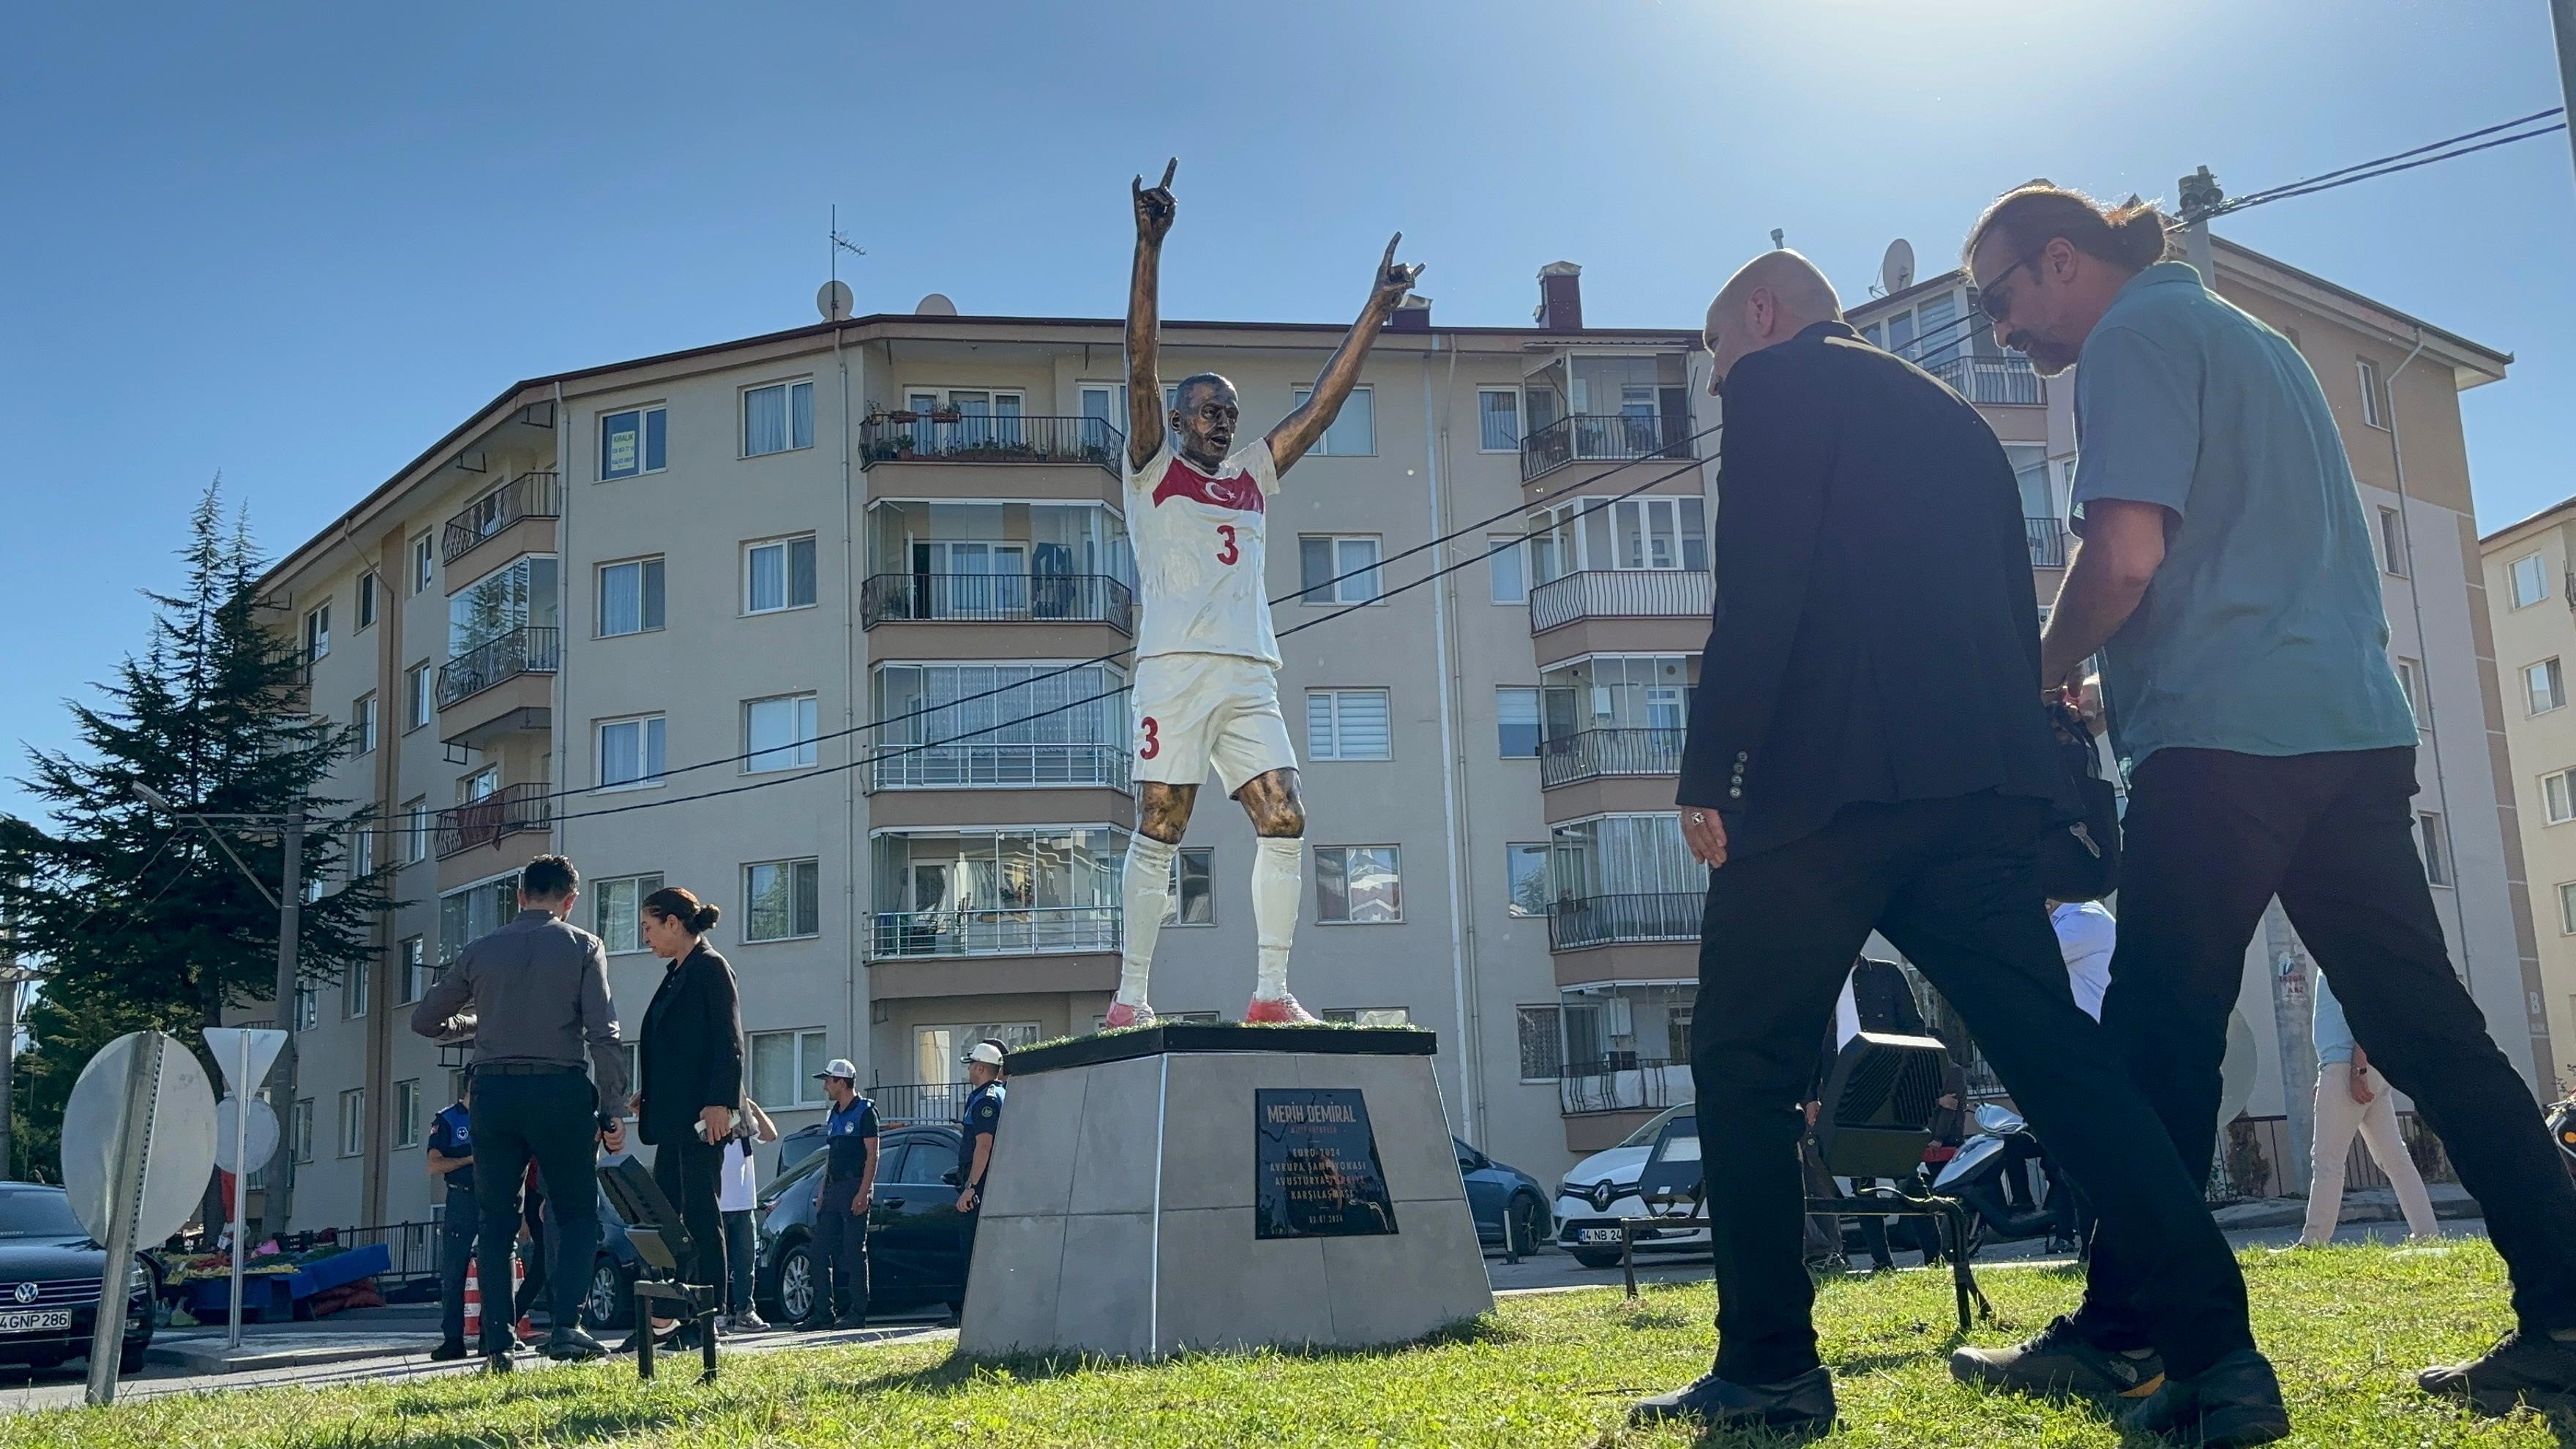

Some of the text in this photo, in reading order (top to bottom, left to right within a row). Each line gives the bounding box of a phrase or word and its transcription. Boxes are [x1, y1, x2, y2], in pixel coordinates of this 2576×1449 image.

[1216, 525, 1239, 566] 3
[1139, 716, 1161, 760] 3
[2529, 992, 2541, 1014] B
[1267, 1101, 1357, 1123] MERİH DEMİRAL
[1293, 1147, 1340, 1157] EURO 2024
[1270, 1161, 1366, 1174] AVRUPA ŞAMYONASI
[1582, 1229, 1592, 1240] 14
[1594, 1229, 1608, 1240] NB
[10, 1315, 40, 1328] GNP
[42, 1314, 67, 1326] 286
